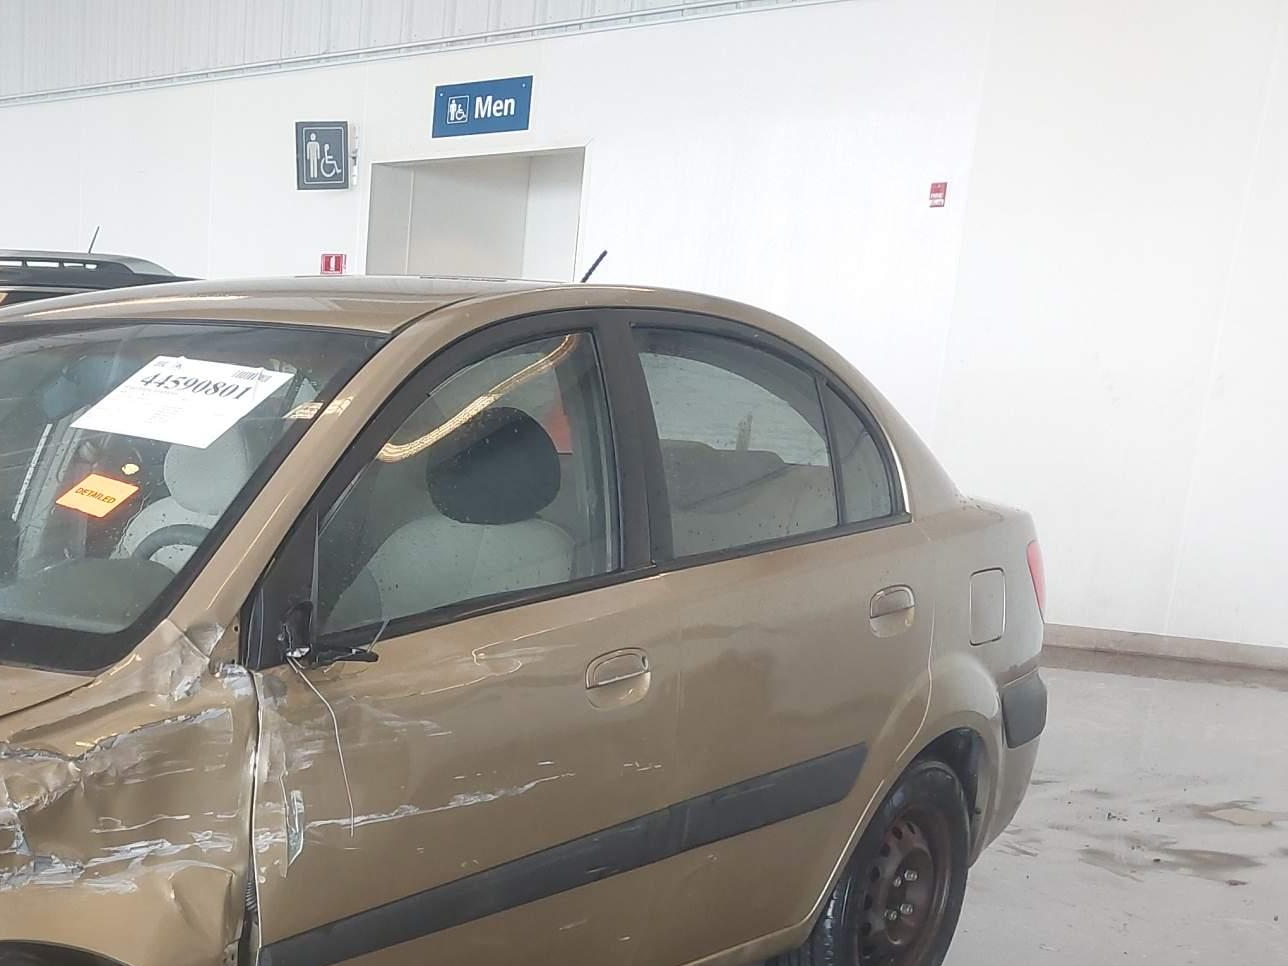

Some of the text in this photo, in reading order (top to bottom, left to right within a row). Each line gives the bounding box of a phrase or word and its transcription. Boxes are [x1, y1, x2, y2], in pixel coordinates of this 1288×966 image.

[474, 95, 516, 119] Men
[140, 373, 252, 400] 44590801
[74, 487, 117, 504] DETAILED
